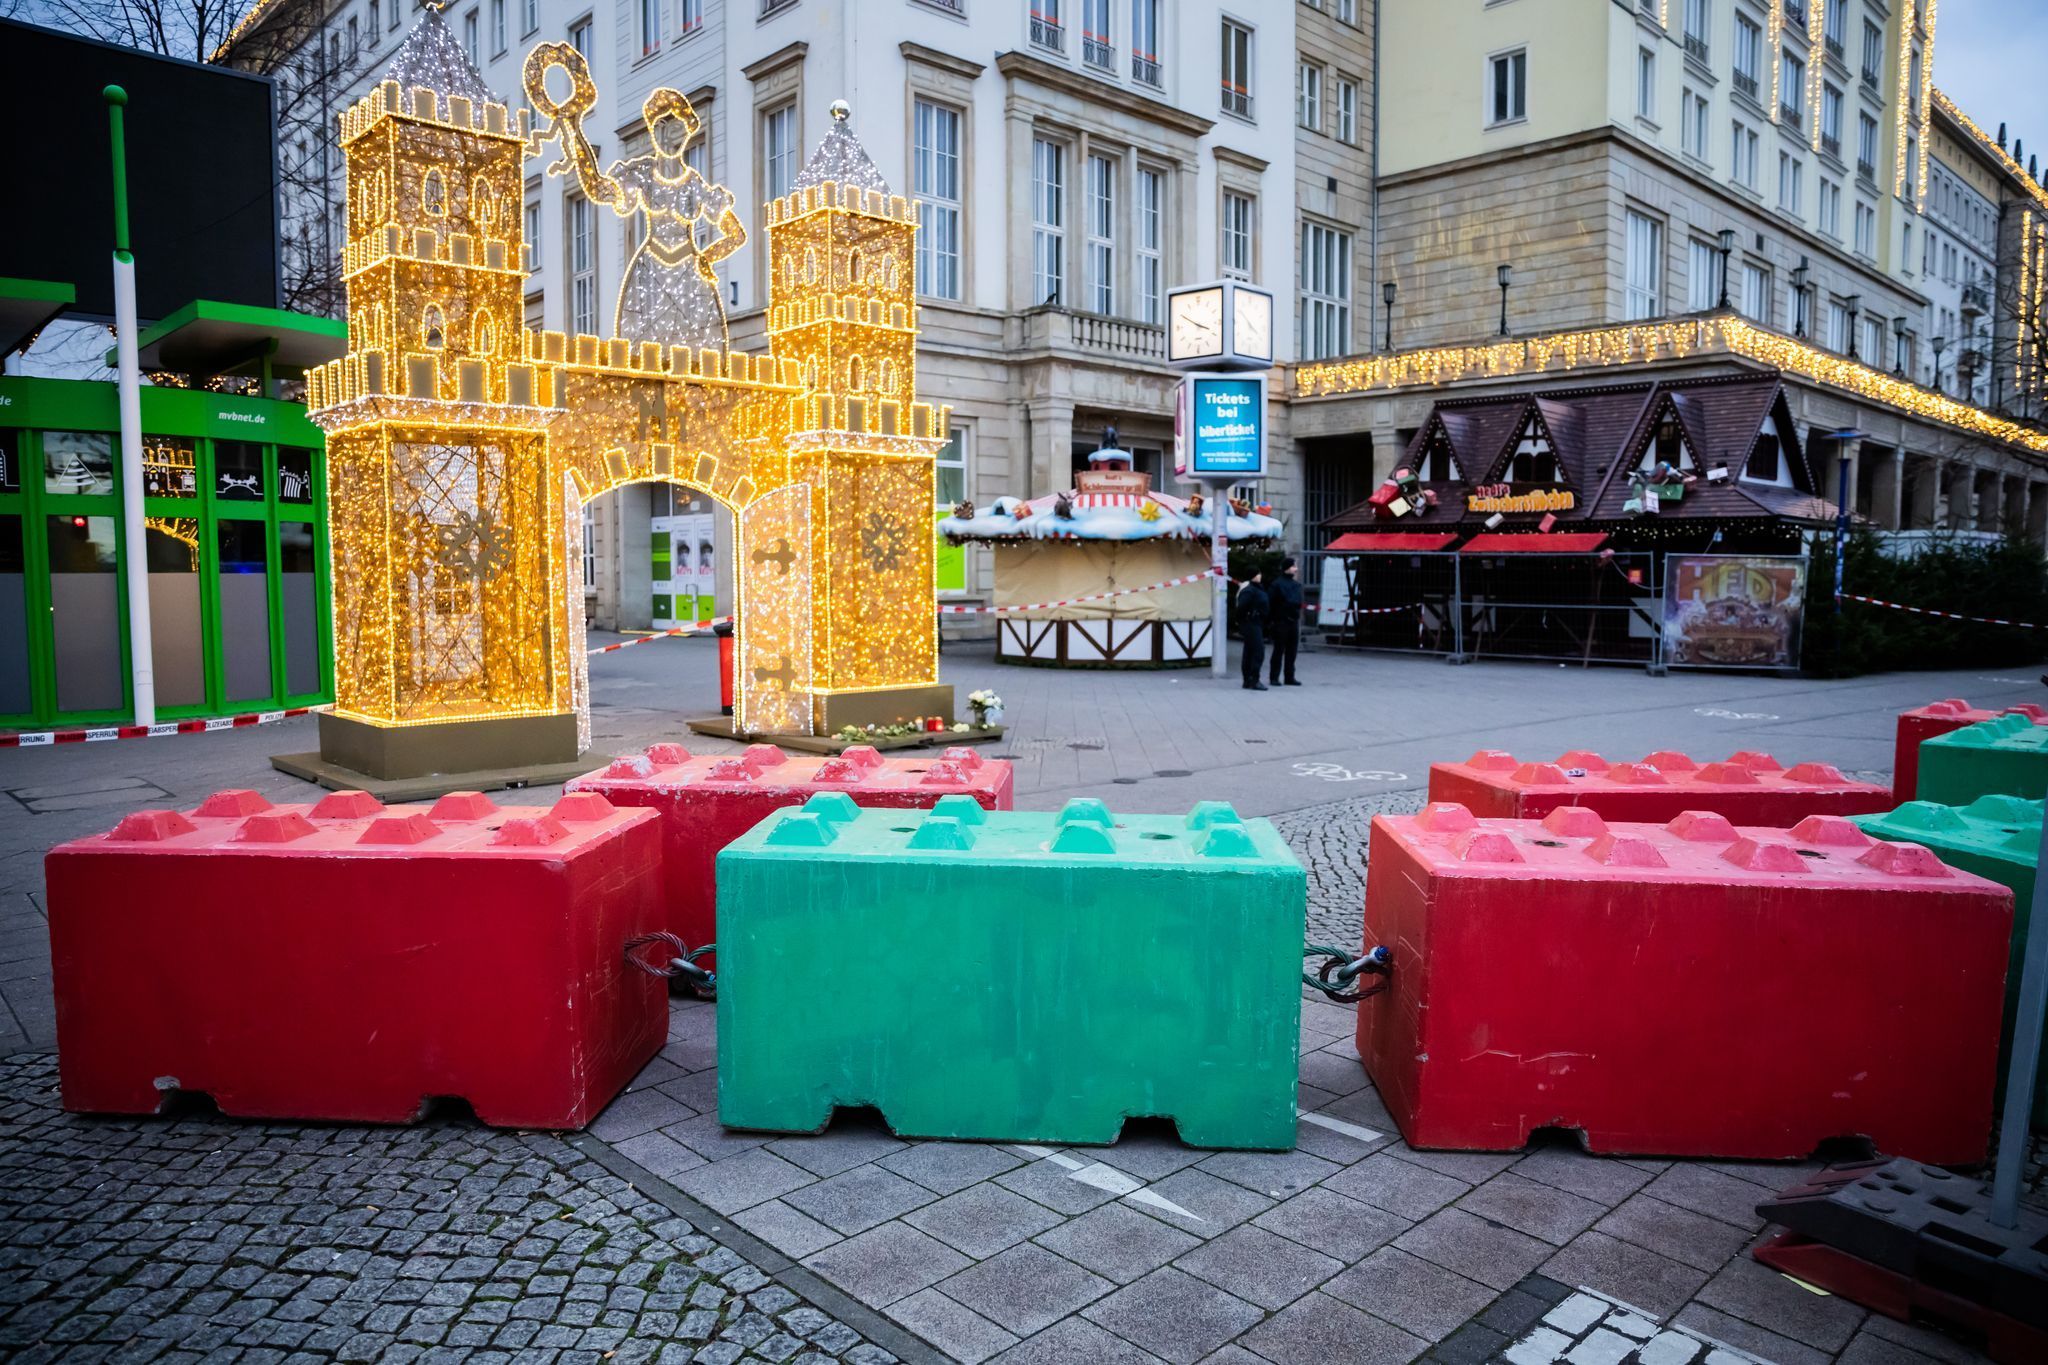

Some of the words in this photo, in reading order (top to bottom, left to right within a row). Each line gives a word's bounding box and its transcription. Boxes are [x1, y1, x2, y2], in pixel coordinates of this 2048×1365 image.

[1205, 393, 1250, 405] Tickets
[218, 411, 266, 424] mvbnet.de
[1217, 406, 1238, 418] bei
[1199, 424, 1256, 437] biberticket
